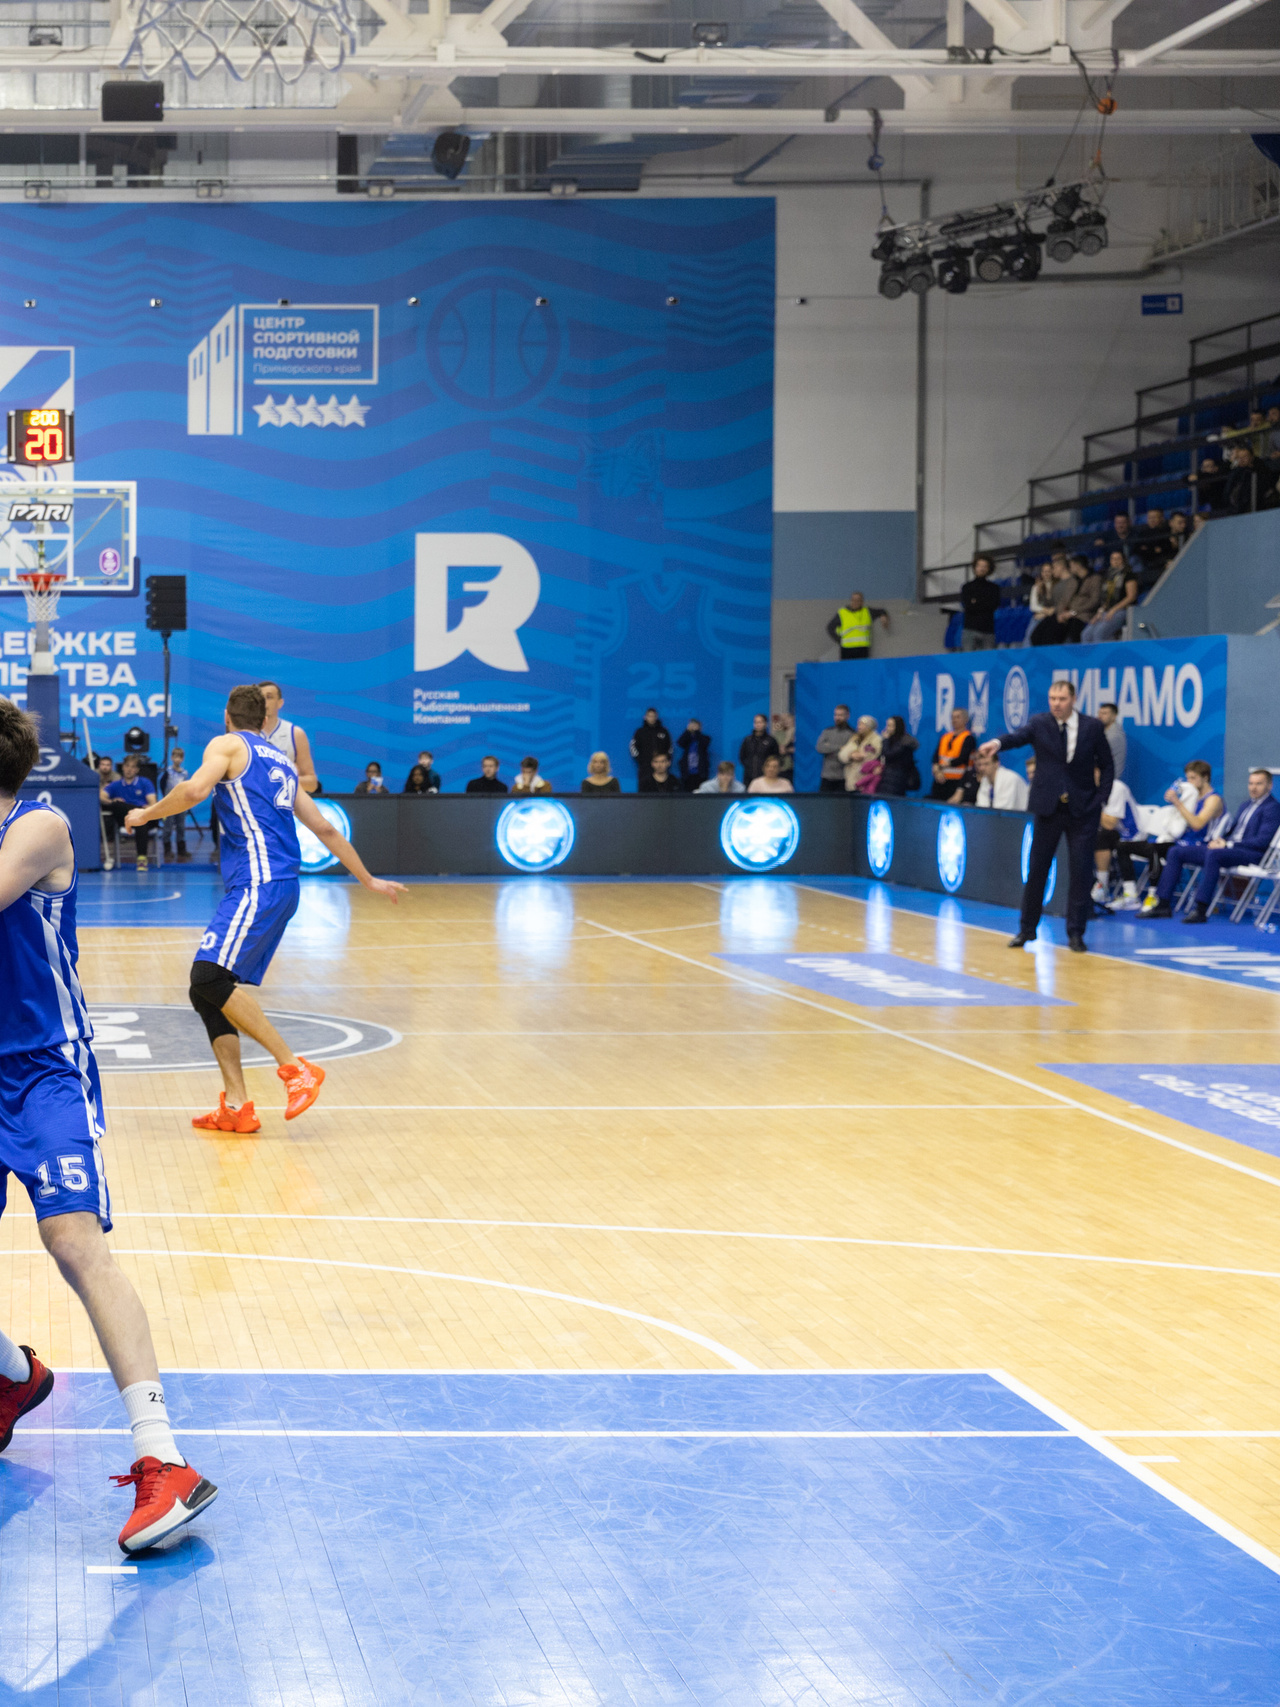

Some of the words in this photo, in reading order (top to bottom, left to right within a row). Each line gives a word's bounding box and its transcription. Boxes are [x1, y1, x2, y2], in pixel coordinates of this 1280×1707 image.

[253, 317, 305, 331] ЦЕНТР
[253, 330, 360, 344] СПОРТИВНОЙ
[253, 347, 357, 360] ПОДГОТОВКИ
[253, 363, 332, 374] Приморского
[334, 365, 361, 374] края
[24, 428, 63, 460] 20
[9, 504, 73, 521] PARI
[413, 688, 459, 701] Русская
[1052, 663, 1203, 728] ИНАМО
[71, 693, 171, 718] КРАЯ
[413, 702, 530, 714] Рыбопромышленная
[413, 714, 471, 724] Компания
[35, 1153, 91, 1199] 15
